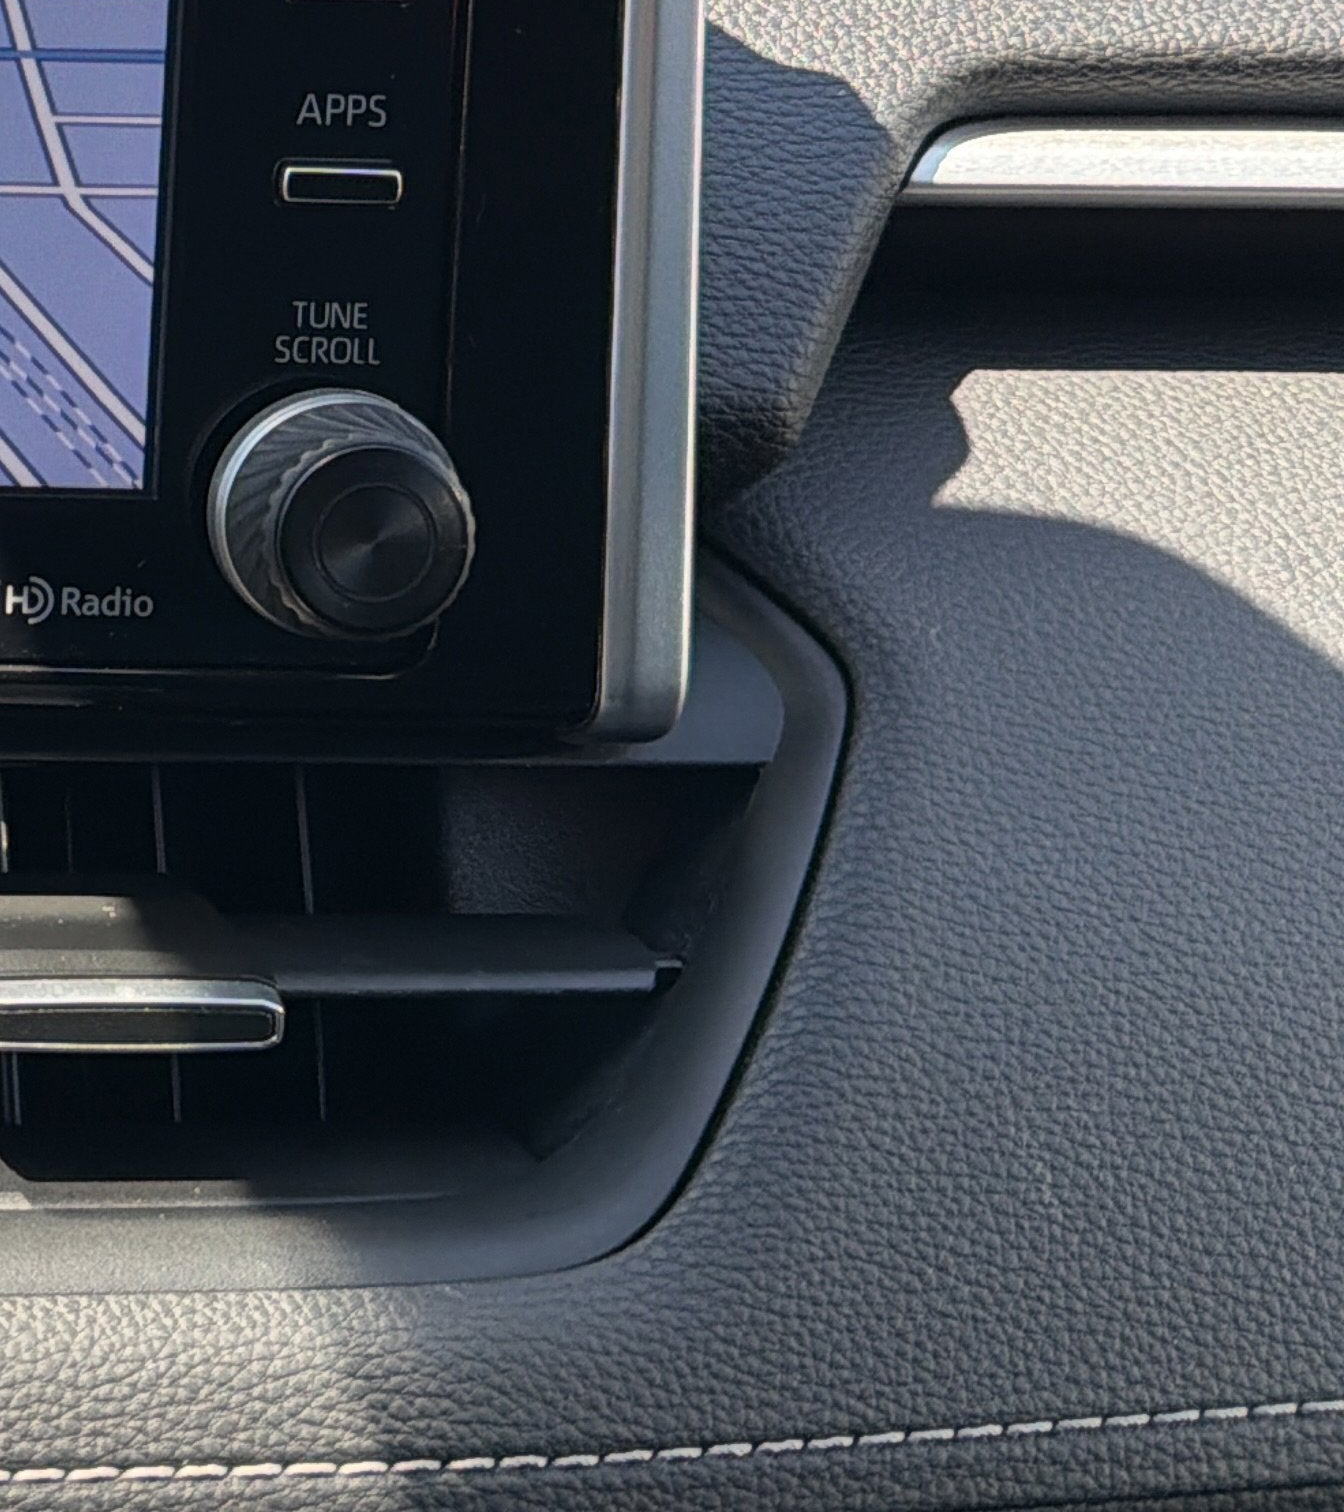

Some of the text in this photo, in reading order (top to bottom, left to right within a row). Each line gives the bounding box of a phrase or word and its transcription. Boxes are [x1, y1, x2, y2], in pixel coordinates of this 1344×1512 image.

[296, 93, 387, 128] APPS
[292, 300, 368, 330] TUNE
[274, 335, 381, 365] SCROLL
[61, 586, 154, 617] Radio
